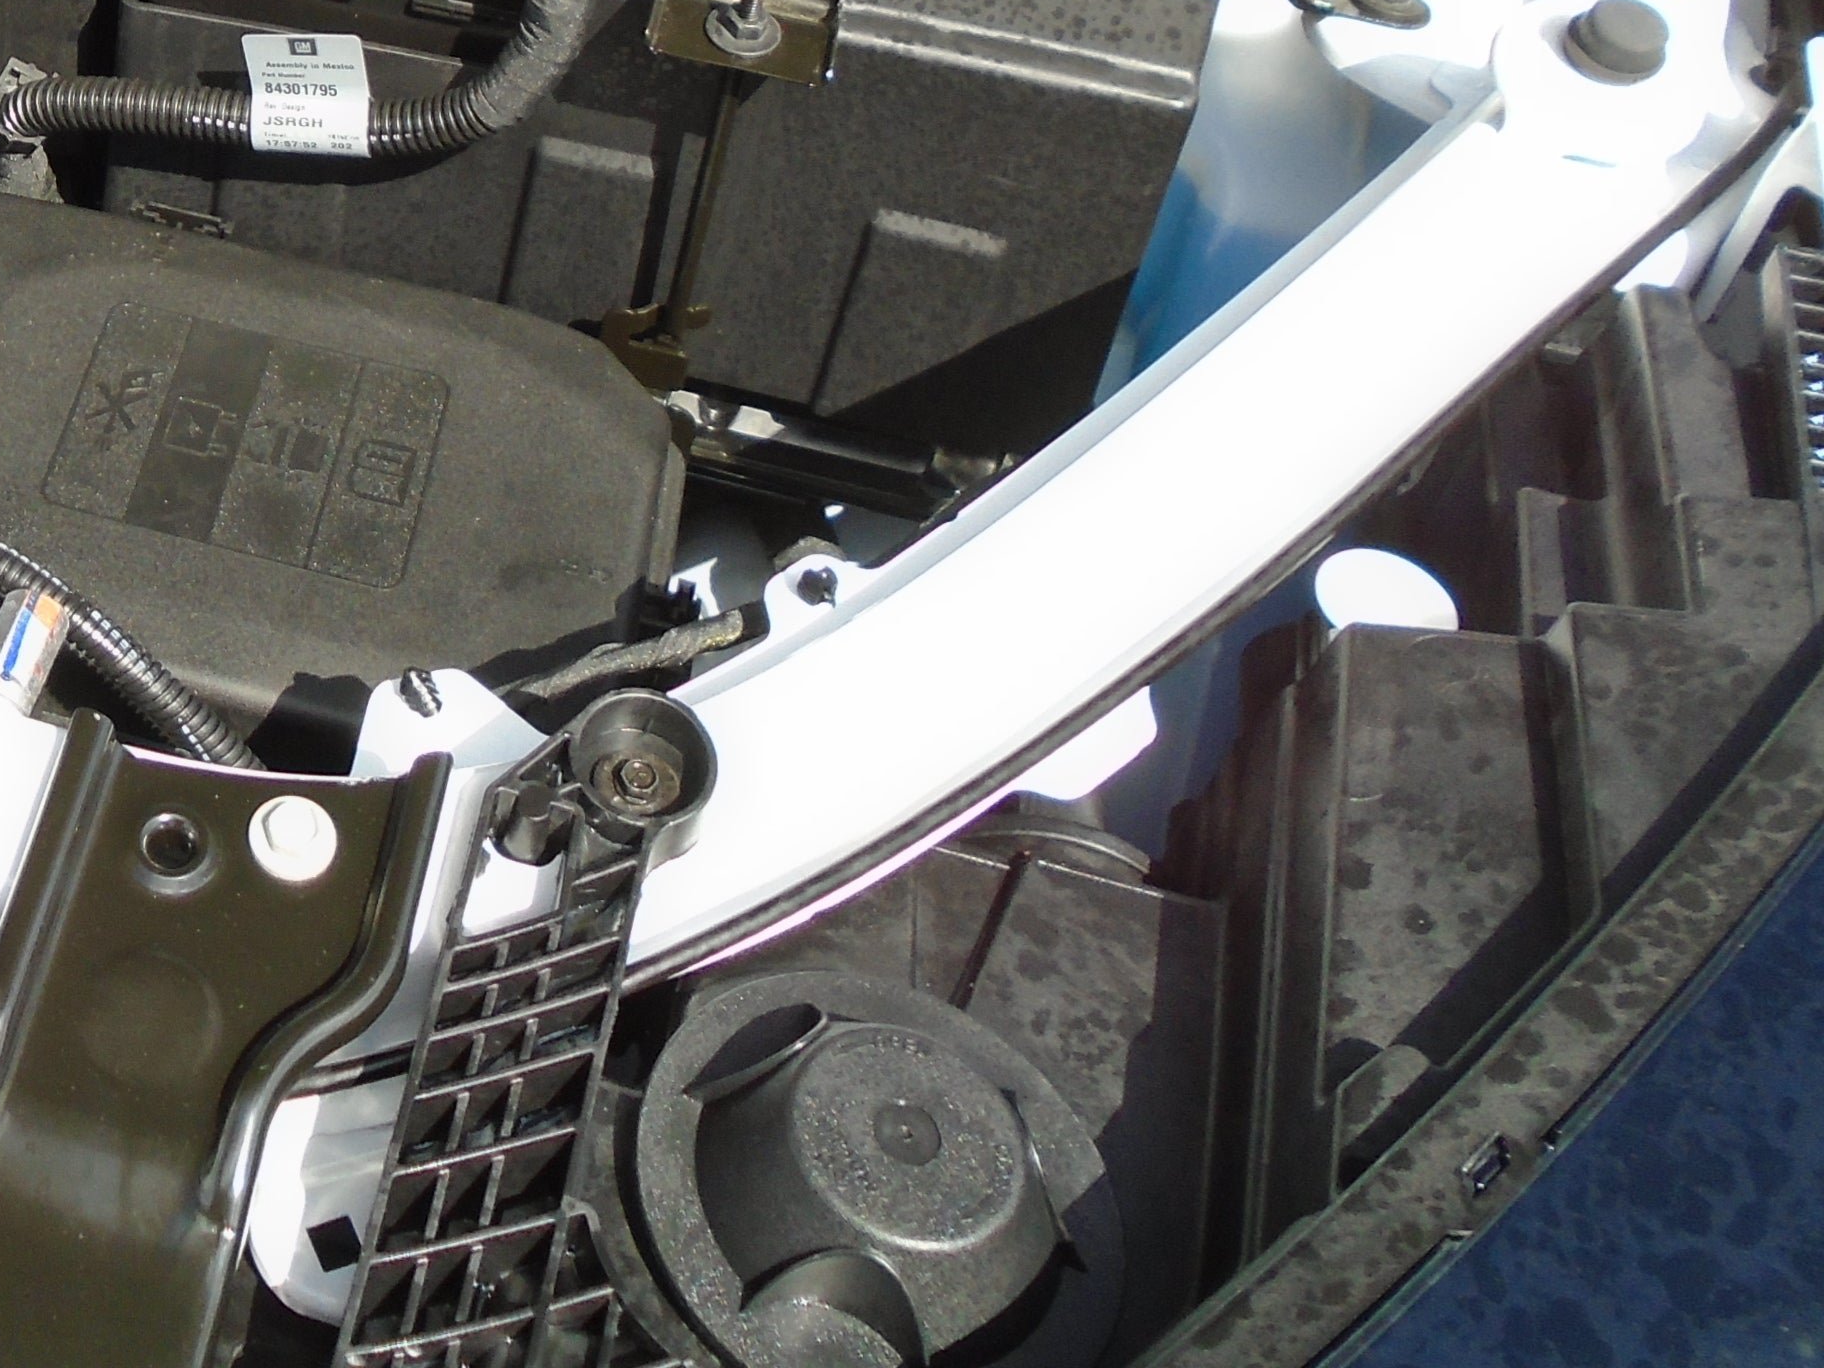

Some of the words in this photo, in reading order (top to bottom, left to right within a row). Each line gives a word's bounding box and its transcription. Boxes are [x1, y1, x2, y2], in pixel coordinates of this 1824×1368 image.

[266, 61, 307, 70] Assembly
[265, 82, 337, 96] 84301795
[263, 116, 323, 128] JSRGH
